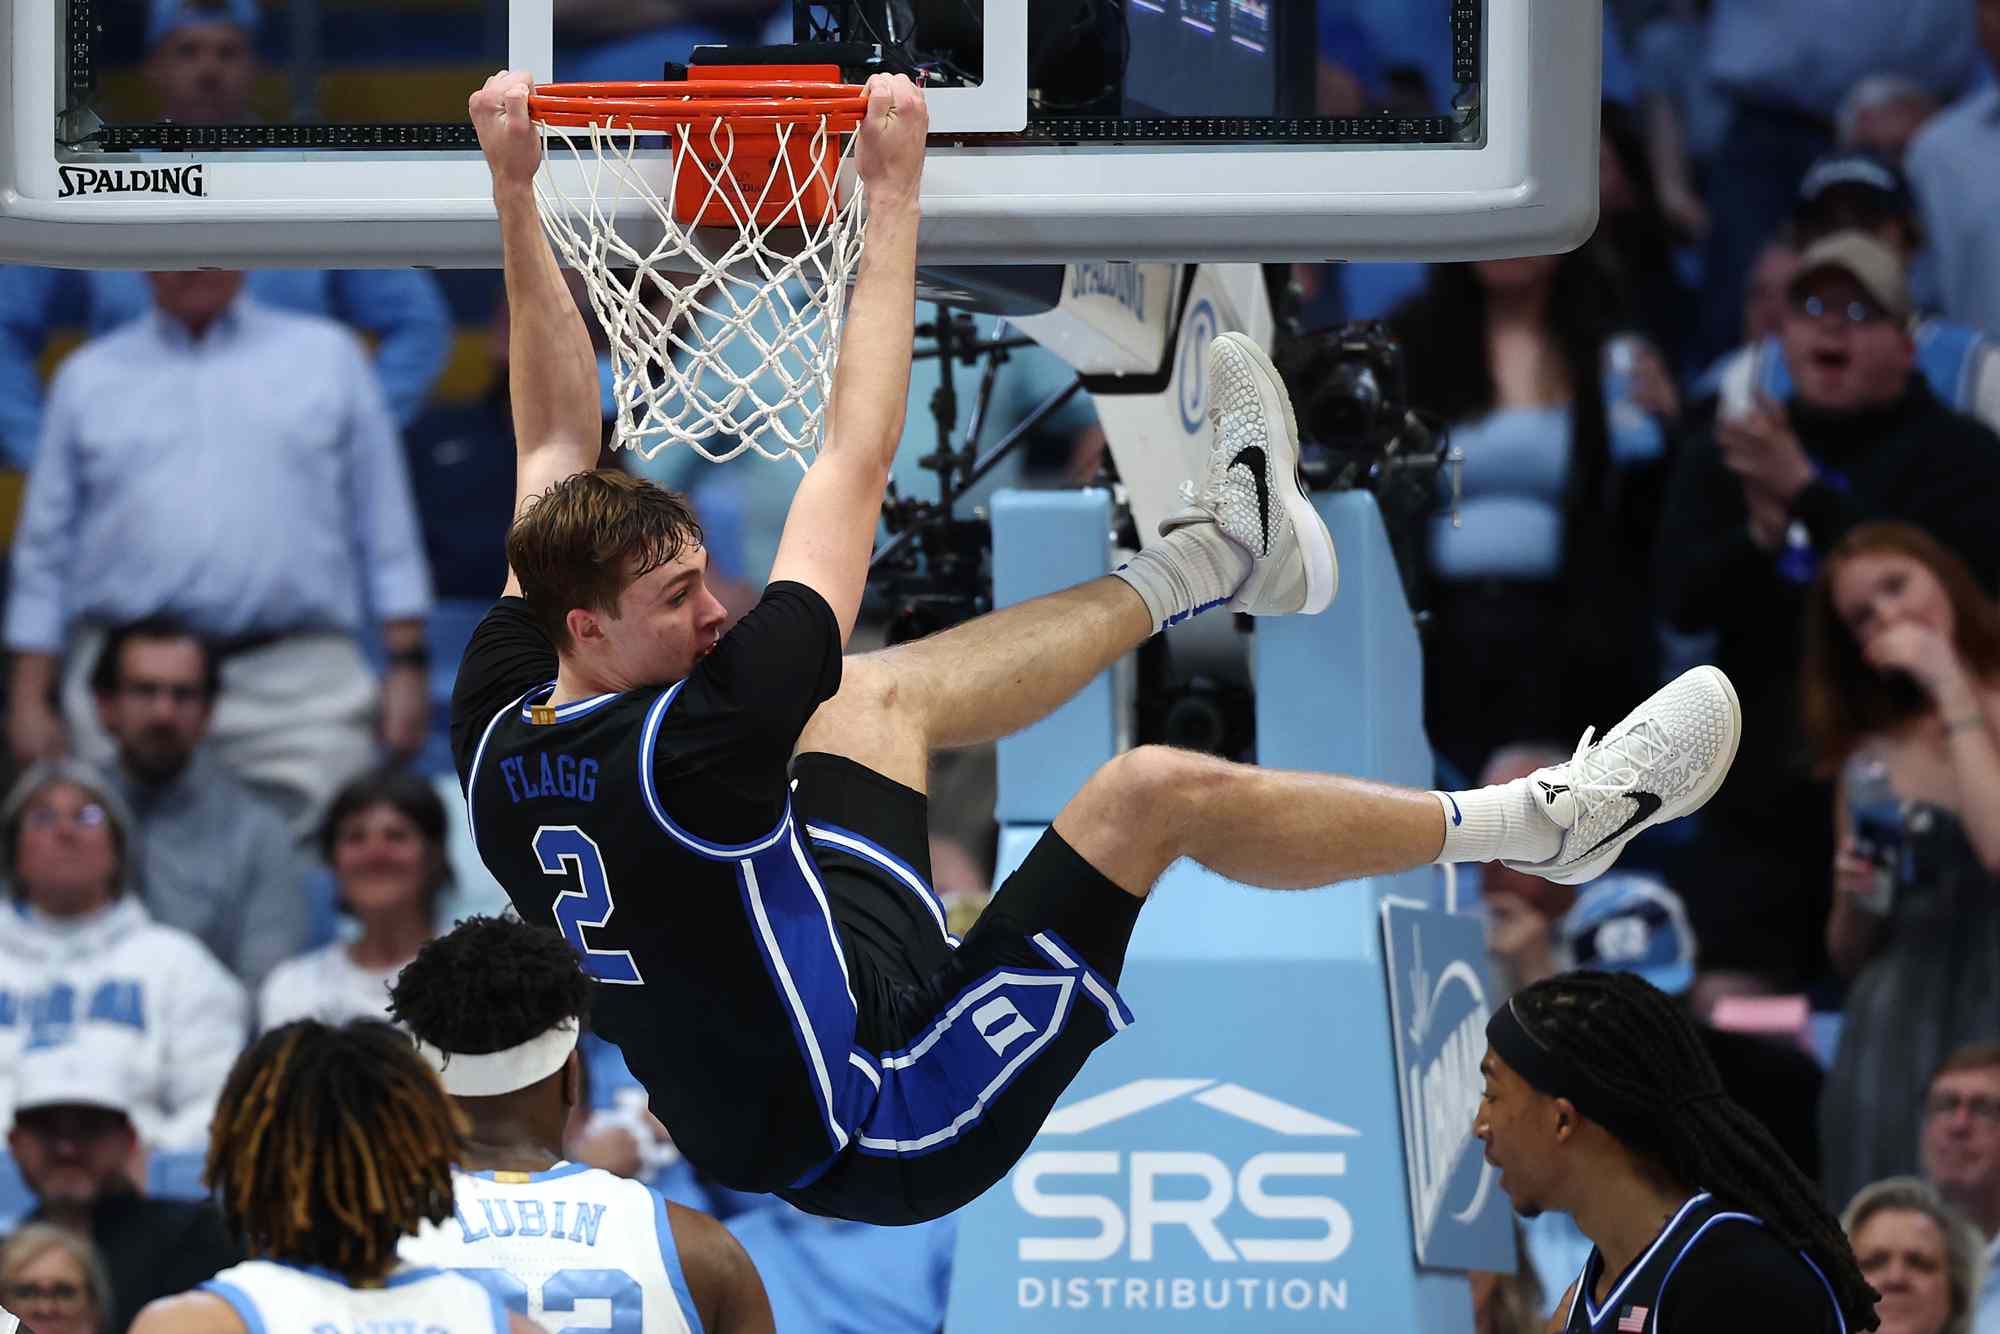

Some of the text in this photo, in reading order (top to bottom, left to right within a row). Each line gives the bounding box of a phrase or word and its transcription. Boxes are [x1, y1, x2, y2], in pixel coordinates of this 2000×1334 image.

[58, 164, 203, 198] SPALDING
[500, 751, 600, 804] FLAGG
[532, 825, 645, 985] 2
[456, 1199, 607, 1247] LUBIN
[1012, 1151, 1353, 1263] SRS
[1018, 1277, 1347, 1311] DISTRIBUTION
